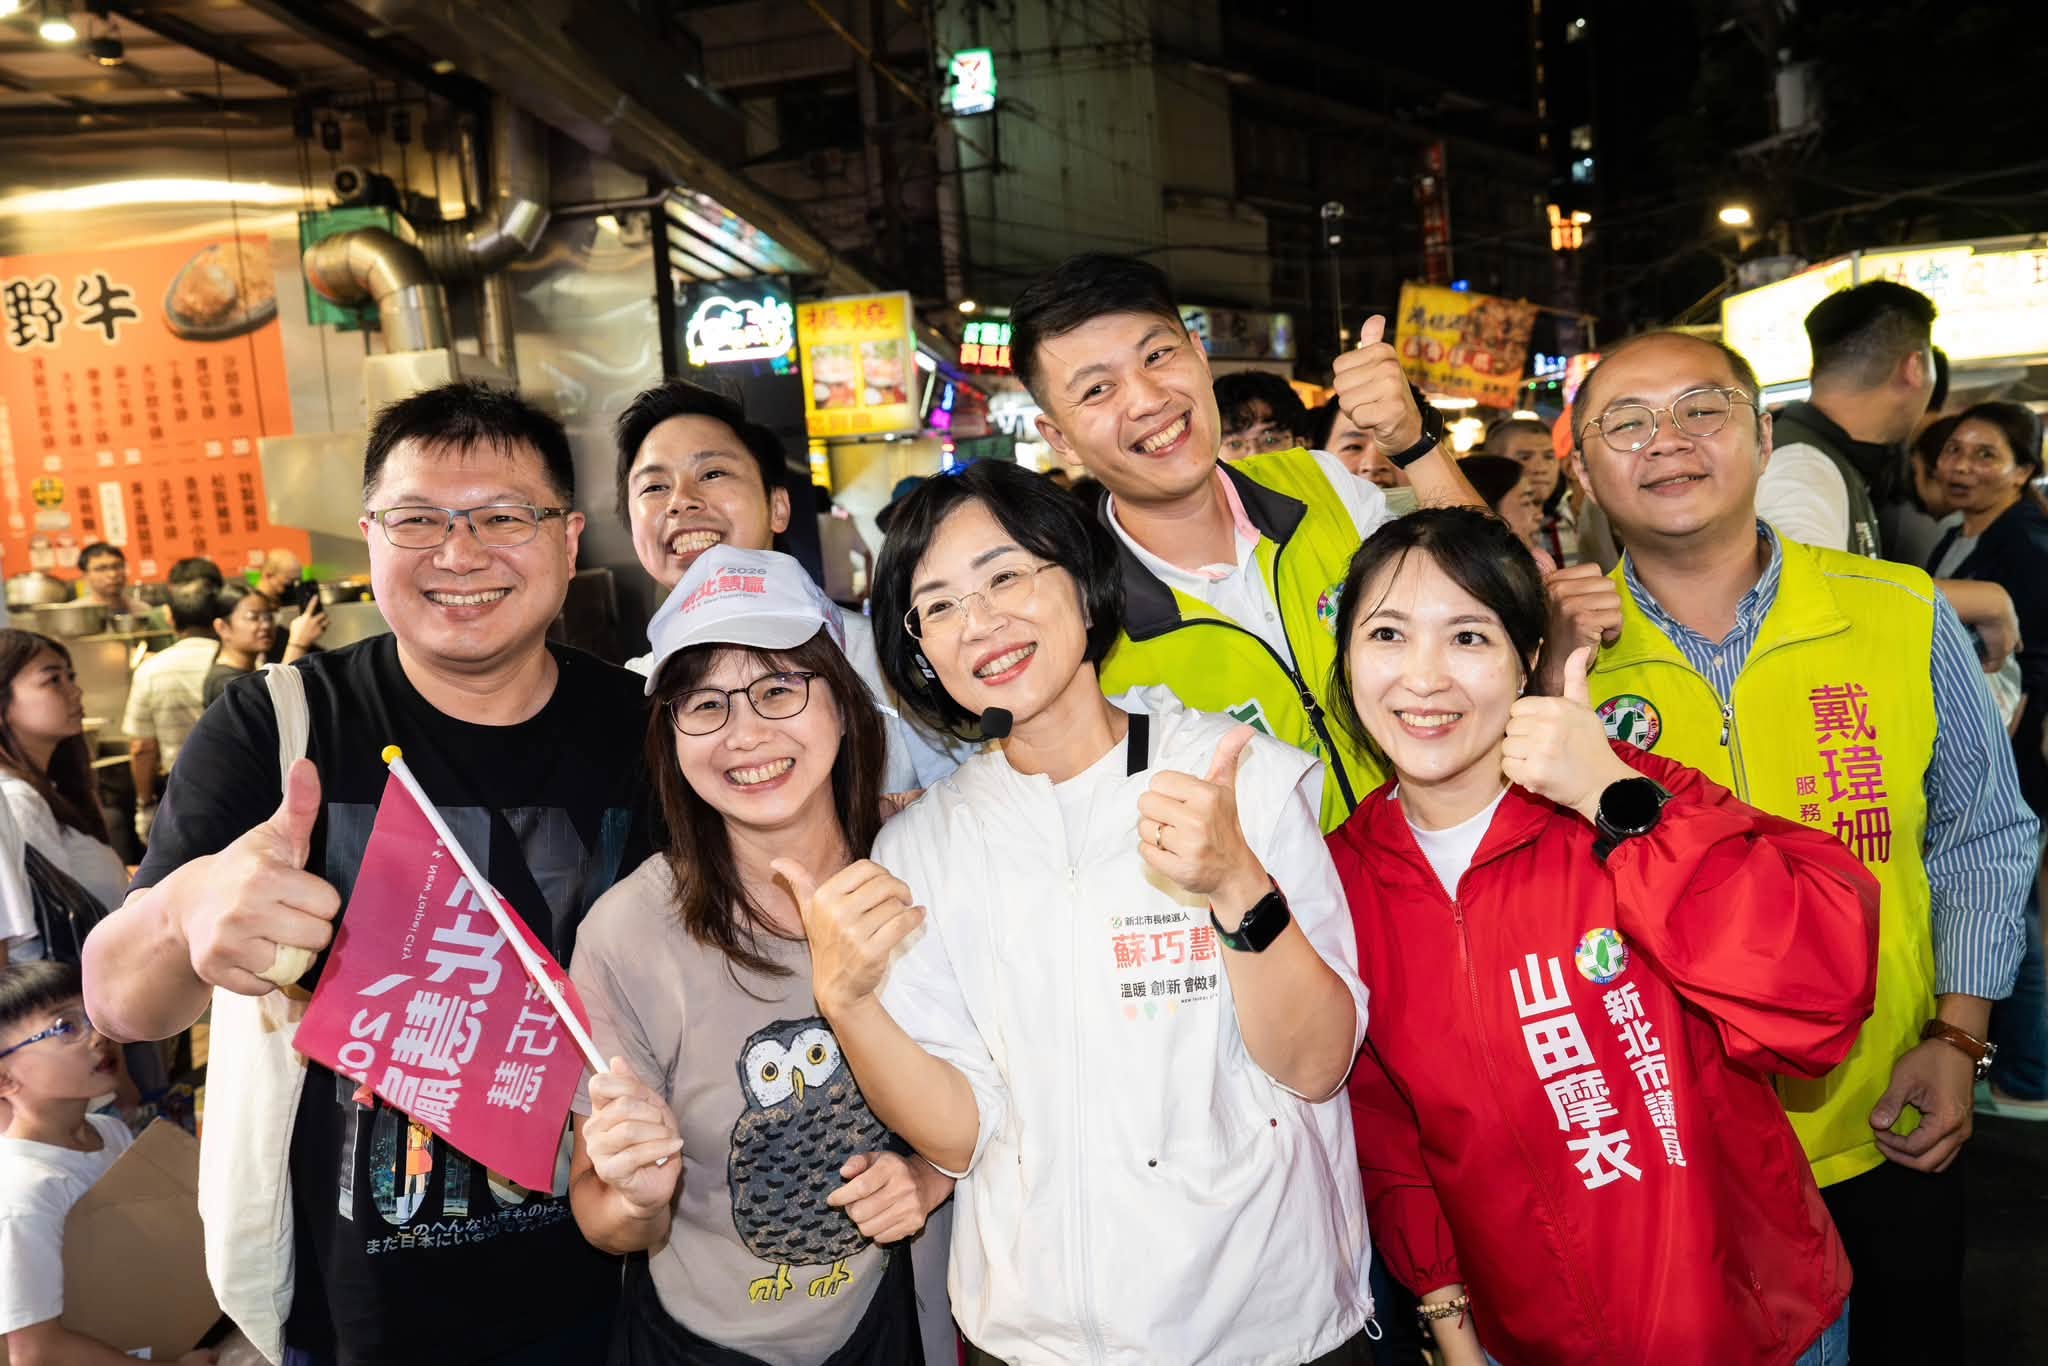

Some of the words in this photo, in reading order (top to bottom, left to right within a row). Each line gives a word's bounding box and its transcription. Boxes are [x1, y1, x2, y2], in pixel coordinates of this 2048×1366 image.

[4, 274, 137, 347] 野牛
[727, 567, 768, 575] 2026
[1796, 775, 1822, 823] 服務
[1125, 911, 1191, 927] 新北市長候選人
[1111, 925, 1217, 969] 蘇巧慧
[1120, 981, 1147, 999] 溫暖
[1150, 978, 1181, 997] 創新
[1508, 953, 1643, 1191] 山田摩衣
[1602, 981, 1687, 1168] 新北市議員
